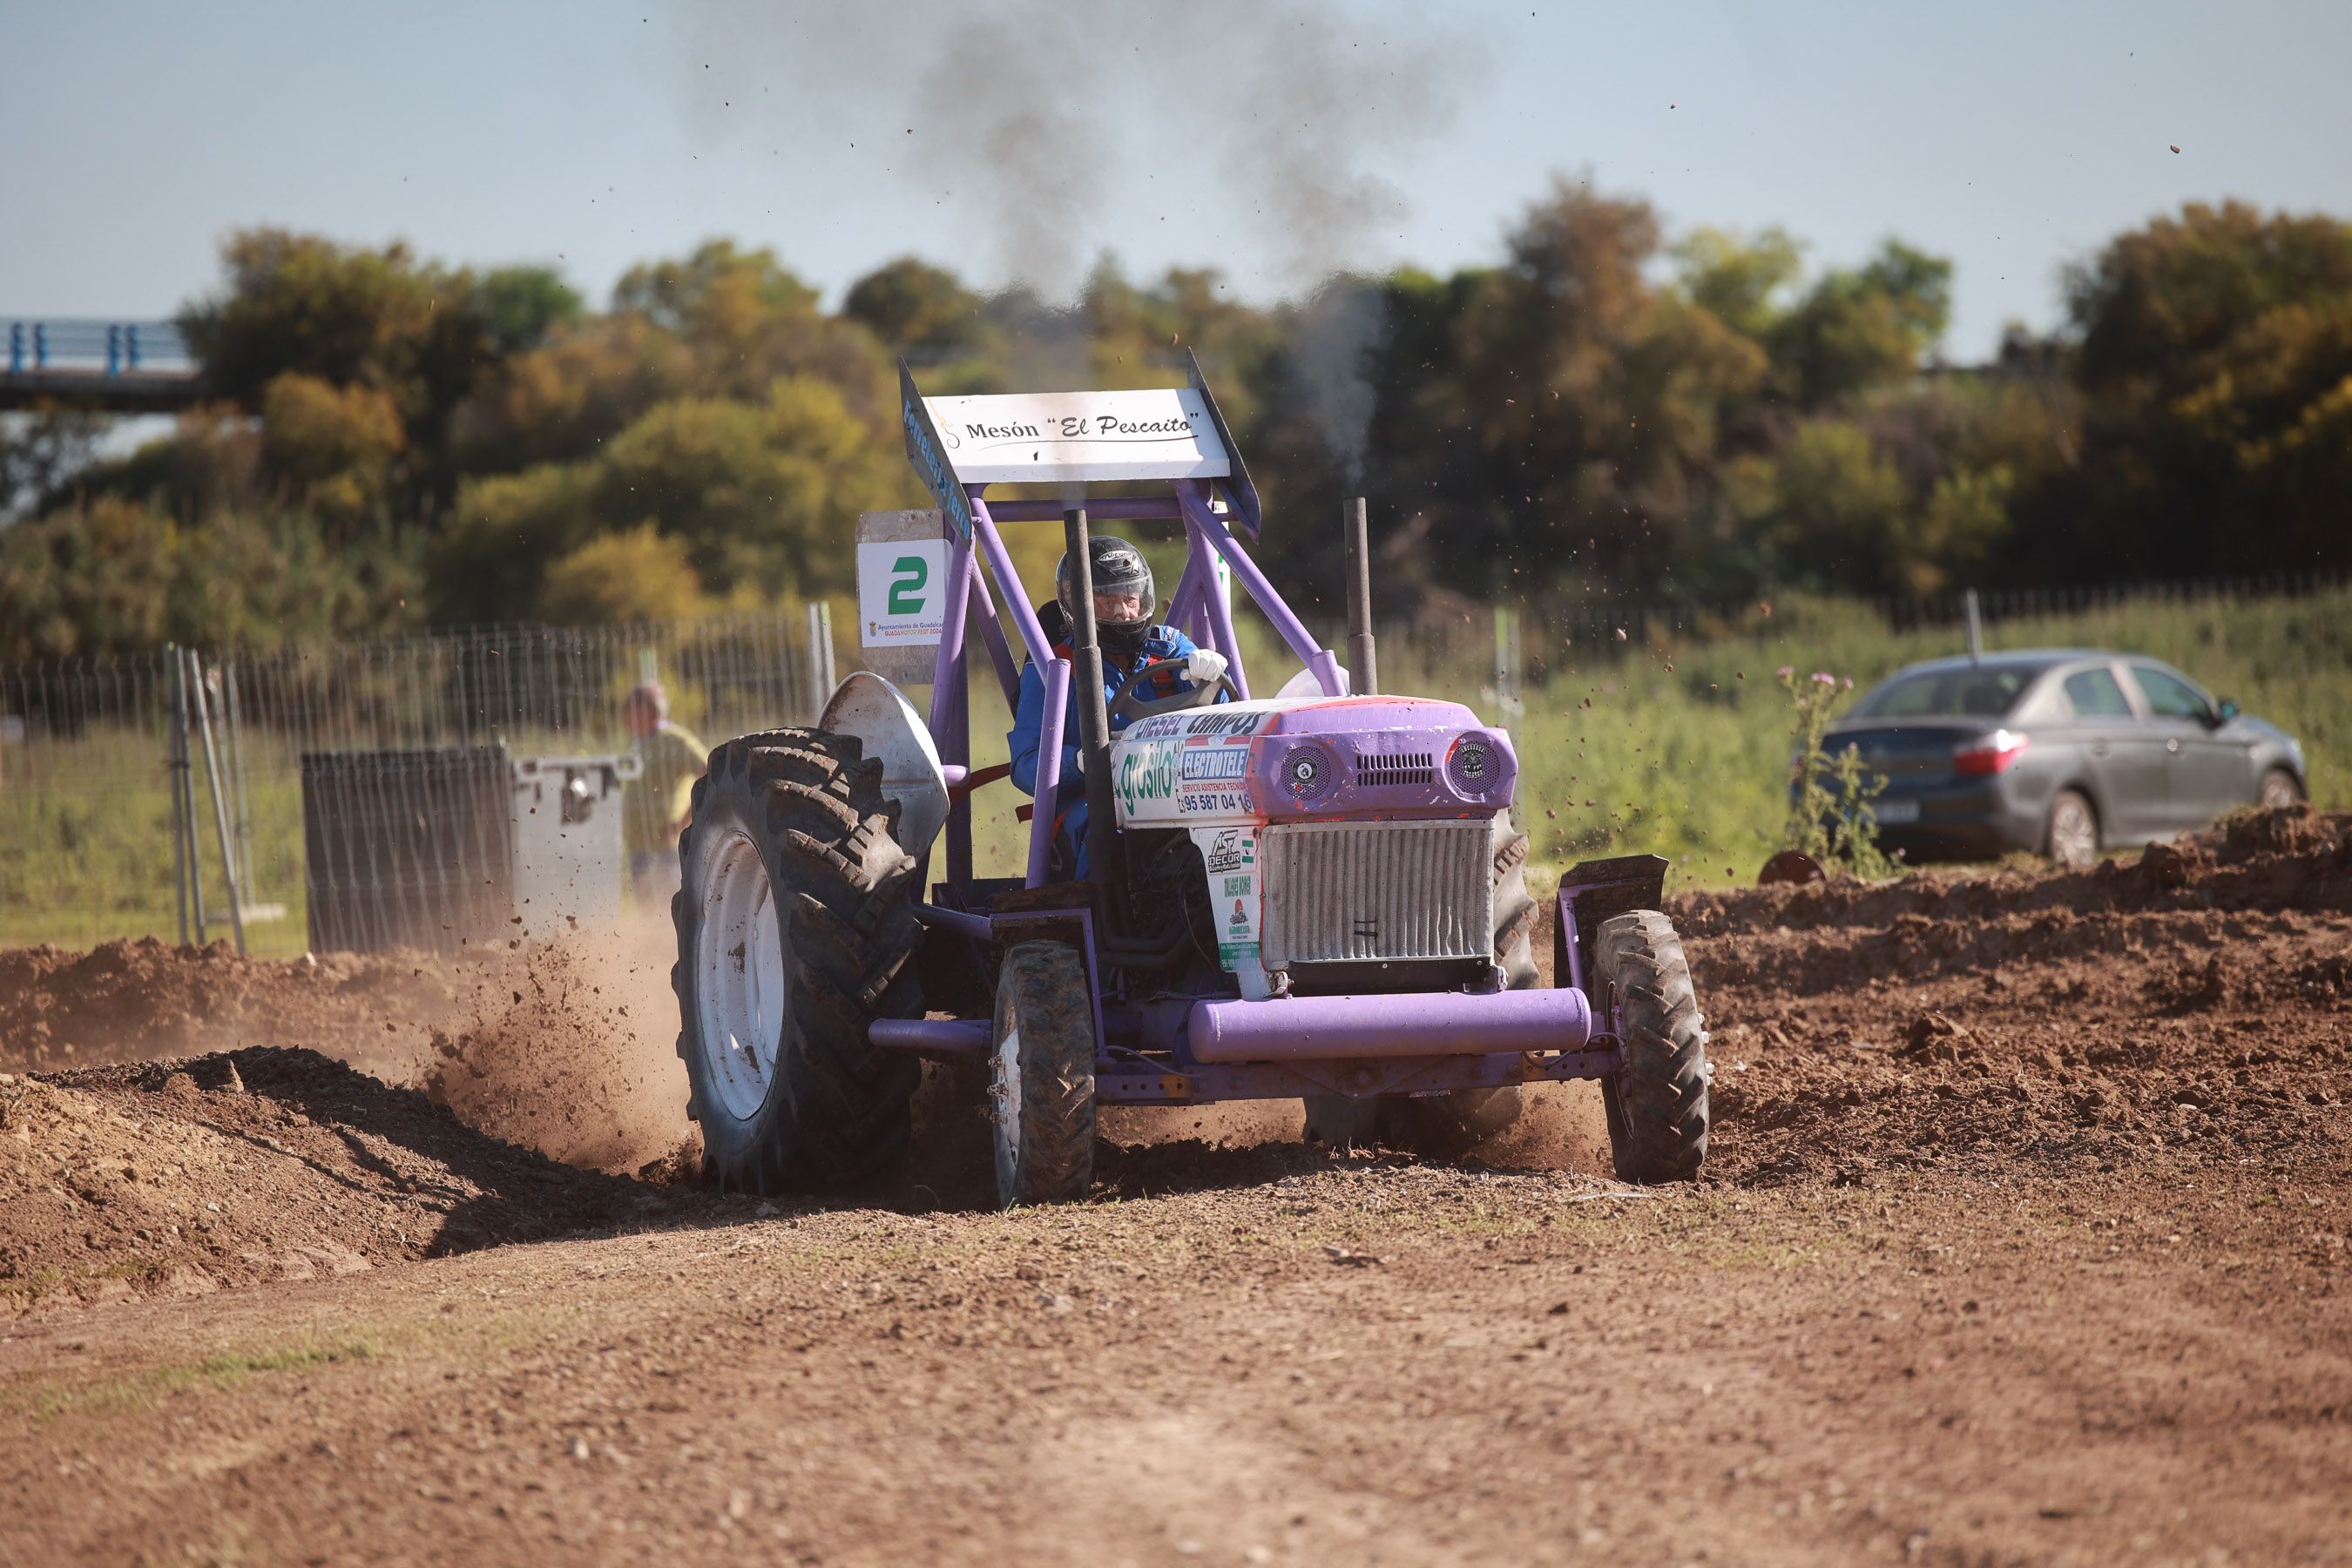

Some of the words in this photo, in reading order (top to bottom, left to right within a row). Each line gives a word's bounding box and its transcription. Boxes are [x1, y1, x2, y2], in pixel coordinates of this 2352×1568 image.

[965, 421, 1040, 438] Mesón
[888, 556, 929, 615] 2
[1135, 715, 1186, 740] DIESEL
[1186, 712, 1267, 735] CAMPOS
[1184, 751, 1246, 778] ELECTROTELE
[1202, 782, 1227, 792] ASISTENCIA
[1185, 794, 1198, 810] 95
[1199, 794, 1217, 810] 587
[1221, 794, 1236, 810] 04
[1238, 794, 1253, 809] 16
[1208, 853, 1240, 866] DECOR
